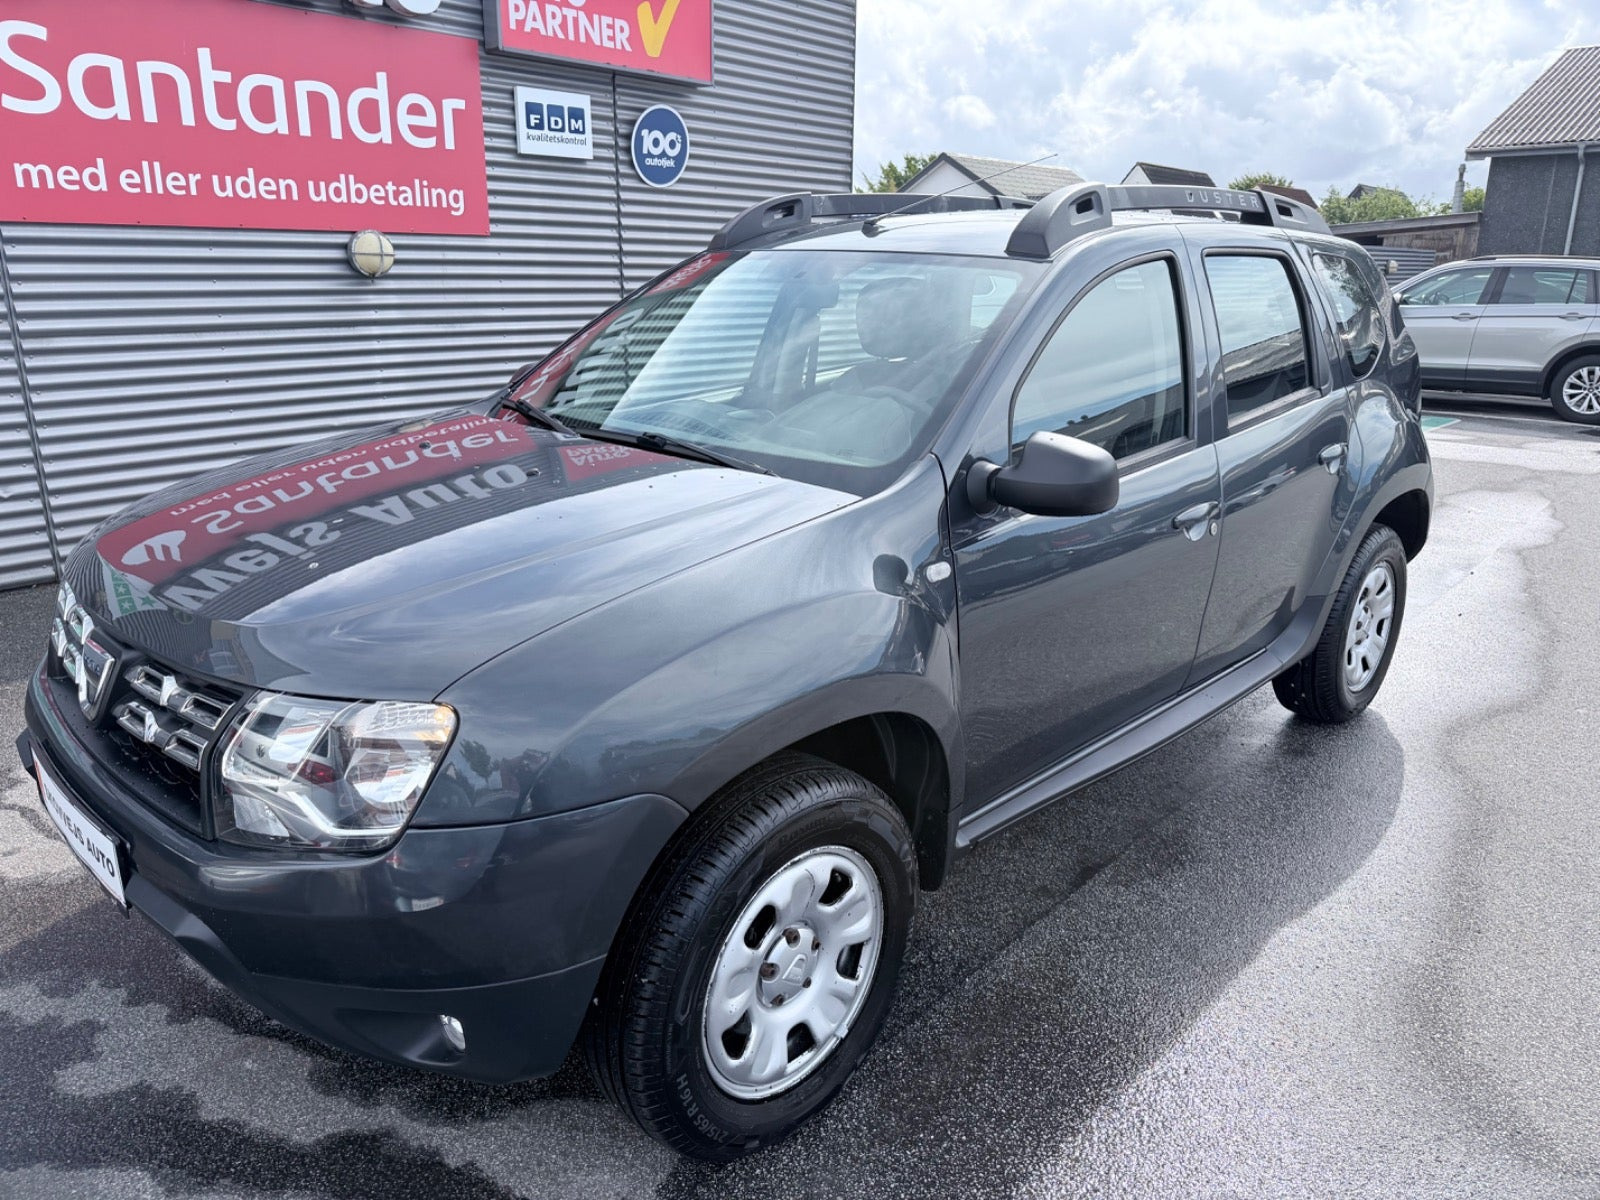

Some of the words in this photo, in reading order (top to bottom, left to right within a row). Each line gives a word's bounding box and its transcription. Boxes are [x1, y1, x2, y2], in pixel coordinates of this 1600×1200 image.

[508, 0, 633, 52] PARTNER
[0, 19, 466, 150] Santander
[526, 131, 587, 147] kvalitetskontrol
[528, 112, 585, 133] FDM
[13, 157, 107, 192] med
[118, 160, 202, 196] eller
[211, 167, 299, 201] uden
[307, 174, 466, 216] udbetaling
[1184, 189, 1260, 209] DUSTER
[87, 837, 115, 878] AUTO
